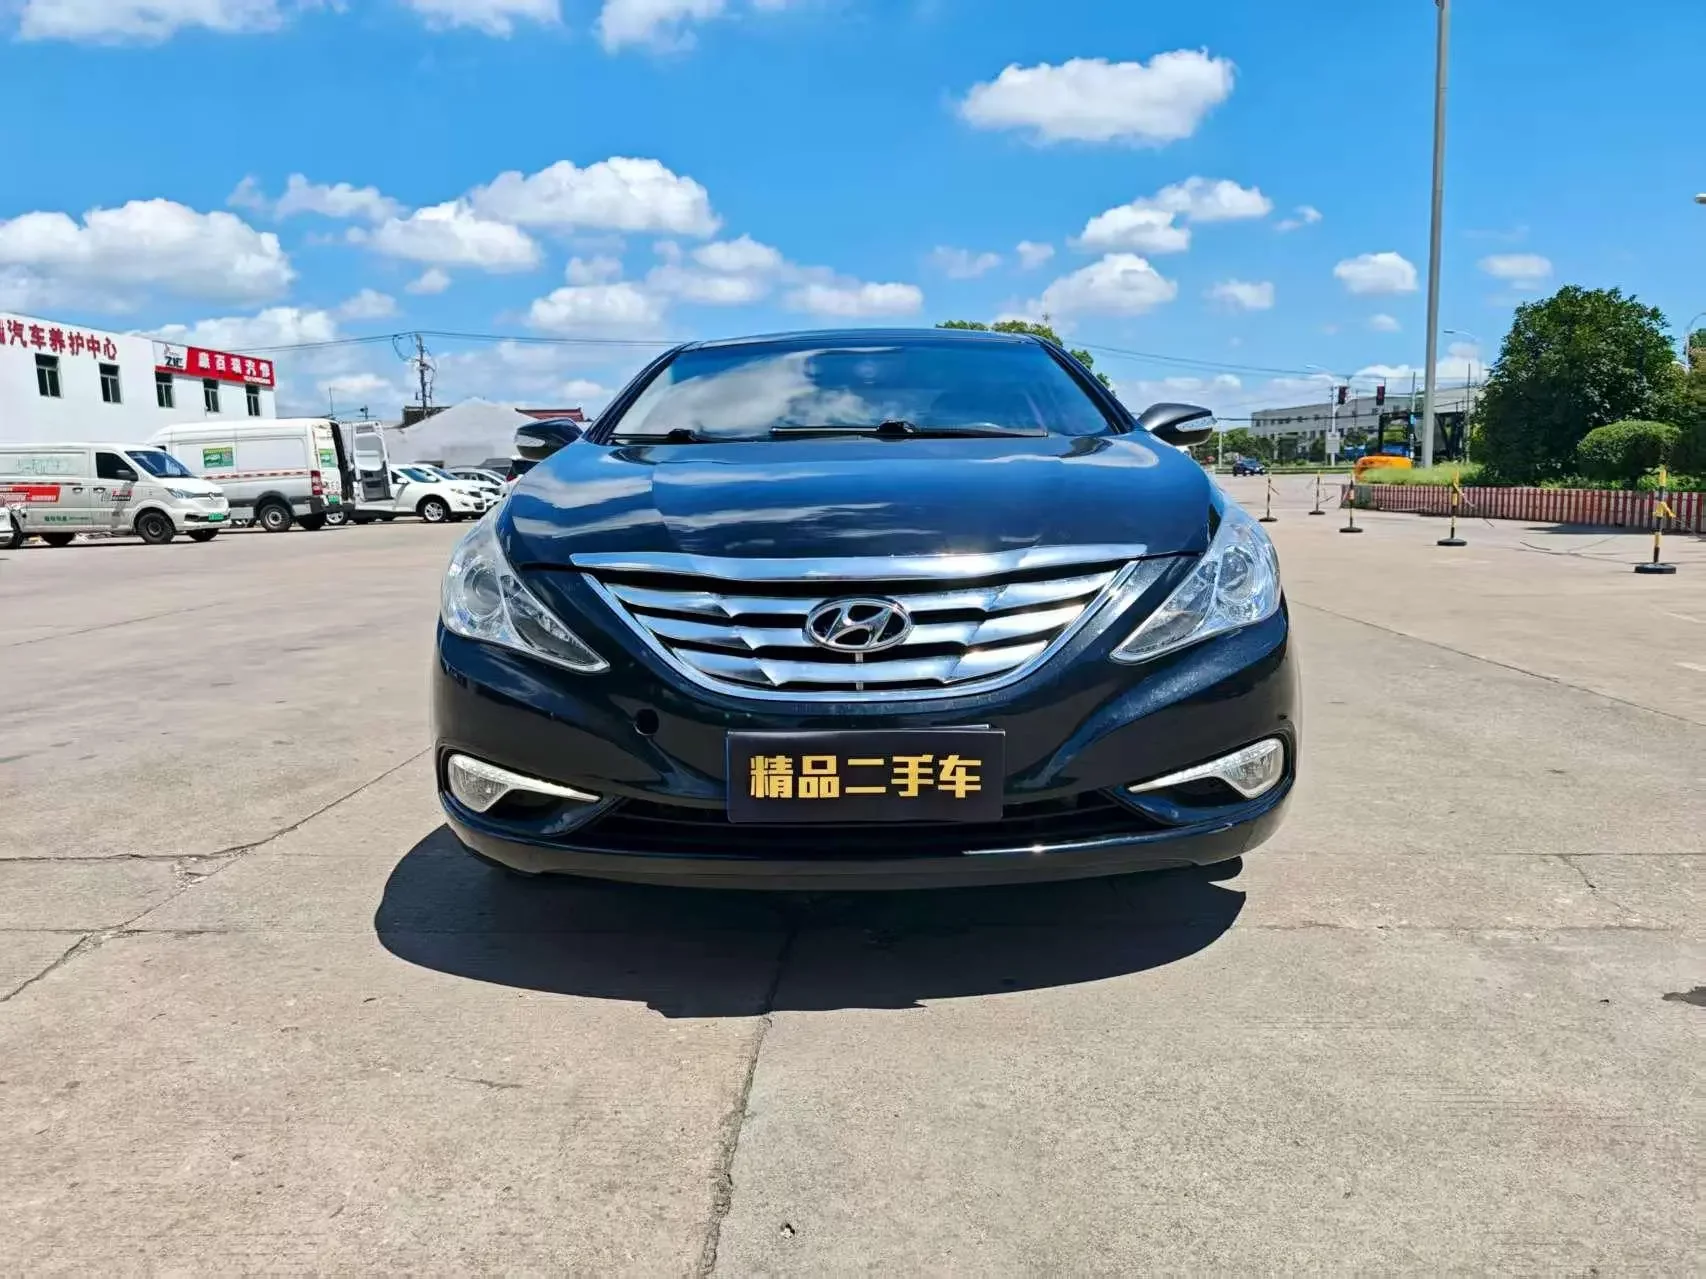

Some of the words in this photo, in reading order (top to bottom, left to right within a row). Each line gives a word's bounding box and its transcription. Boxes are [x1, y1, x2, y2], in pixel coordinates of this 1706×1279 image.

[750, 754, 982, 799] 精品二手车
